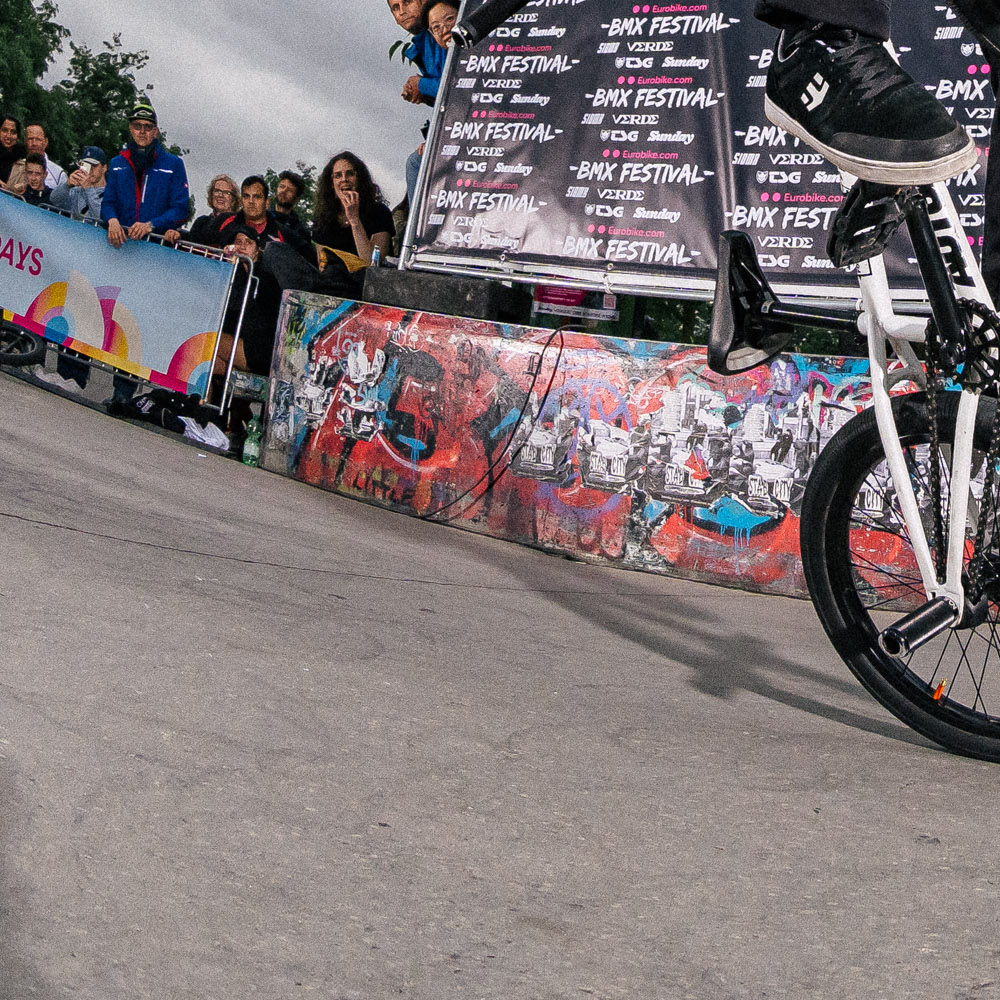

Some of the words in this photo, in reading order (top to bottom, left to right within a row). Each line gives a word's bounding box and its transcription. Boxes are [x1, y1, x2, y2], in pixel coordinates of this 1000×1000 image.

[652, 4, 708, 13] Eurobike.com
[527, 25, 567, 38] Sunday
[505, 44, 552, 52] Eurobike.com
[662, 56, 709, 70] Sunday
[637, 76, 693, 85] Eurobike.com
[510, 93, 550, 106] Sunday
[647, 130, 695, 145] Sunday
[622, 150, 679, 159] Eurobike.com
[494, 162, 533, 177] Sunday
[812, 171, 840, 184] Sun
[633, 207, 681, 223] Sunday
[608, 226, 665, 238] Eurobike.com
[0, 236, 43, 276] AYS
